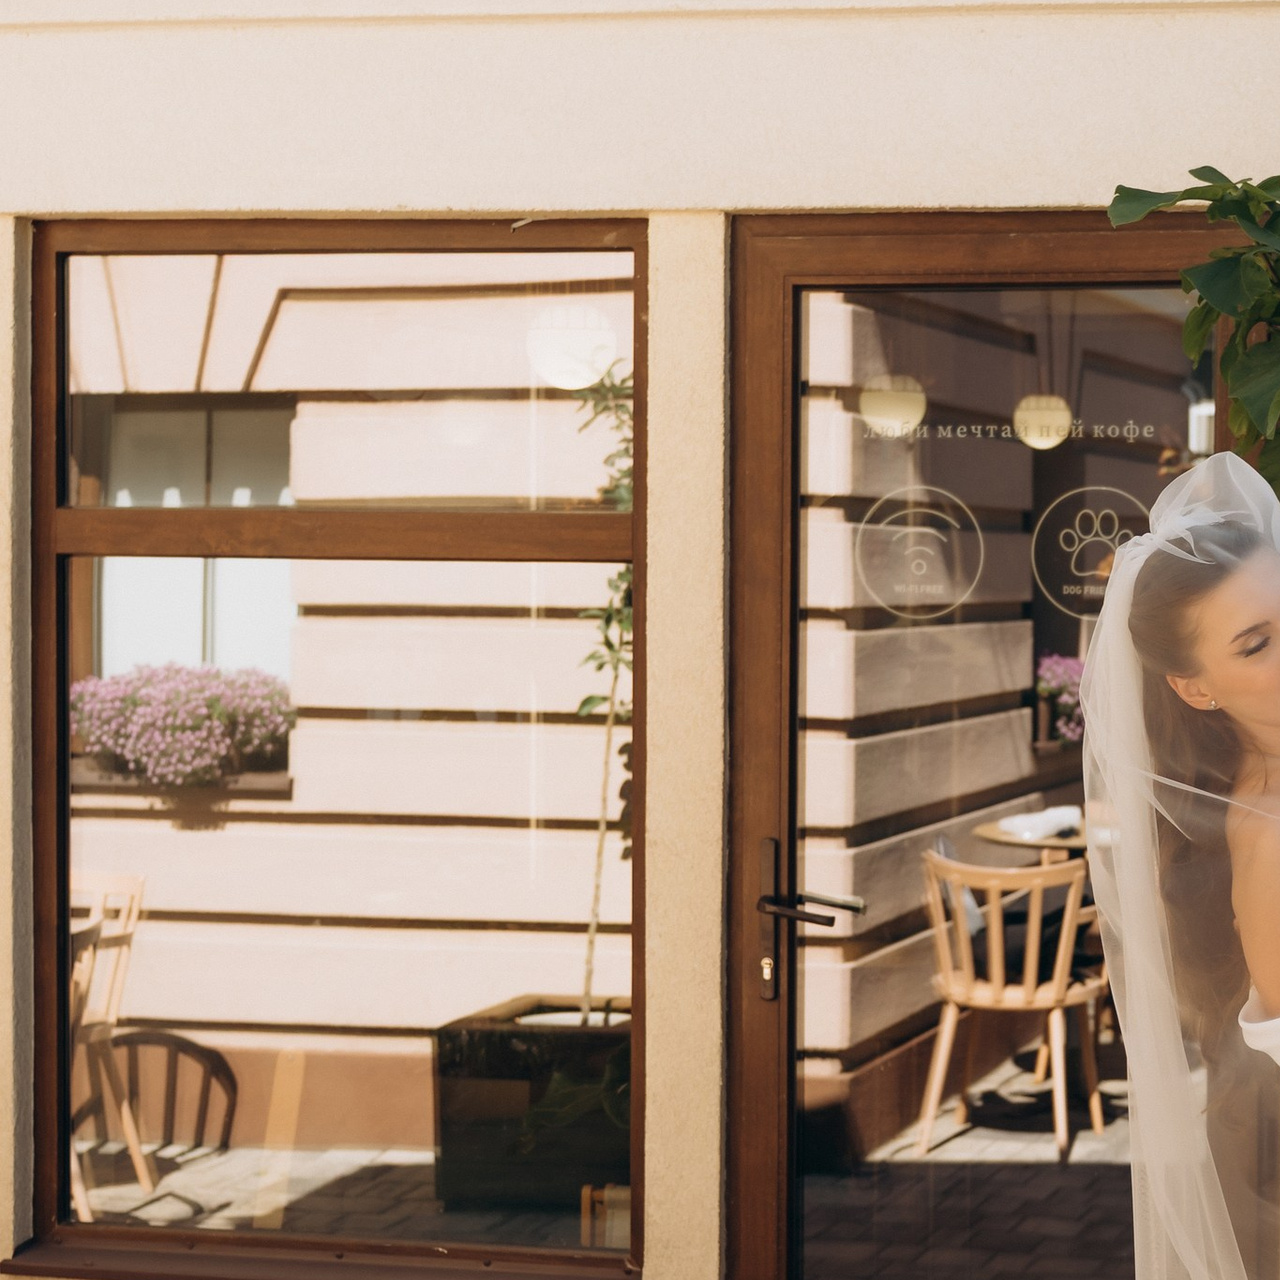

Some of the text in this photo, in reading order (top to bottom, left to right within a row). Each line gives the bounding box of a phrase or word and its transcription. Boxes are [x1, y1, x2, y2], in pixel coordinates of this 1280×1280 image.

[937, 420, 1028, 438] мечтай
[1040, 419, 1084, 438] пей
[1092, 419, 1154, 443] кофе
[1063, 585, 1105, 595] DOG FRIE
